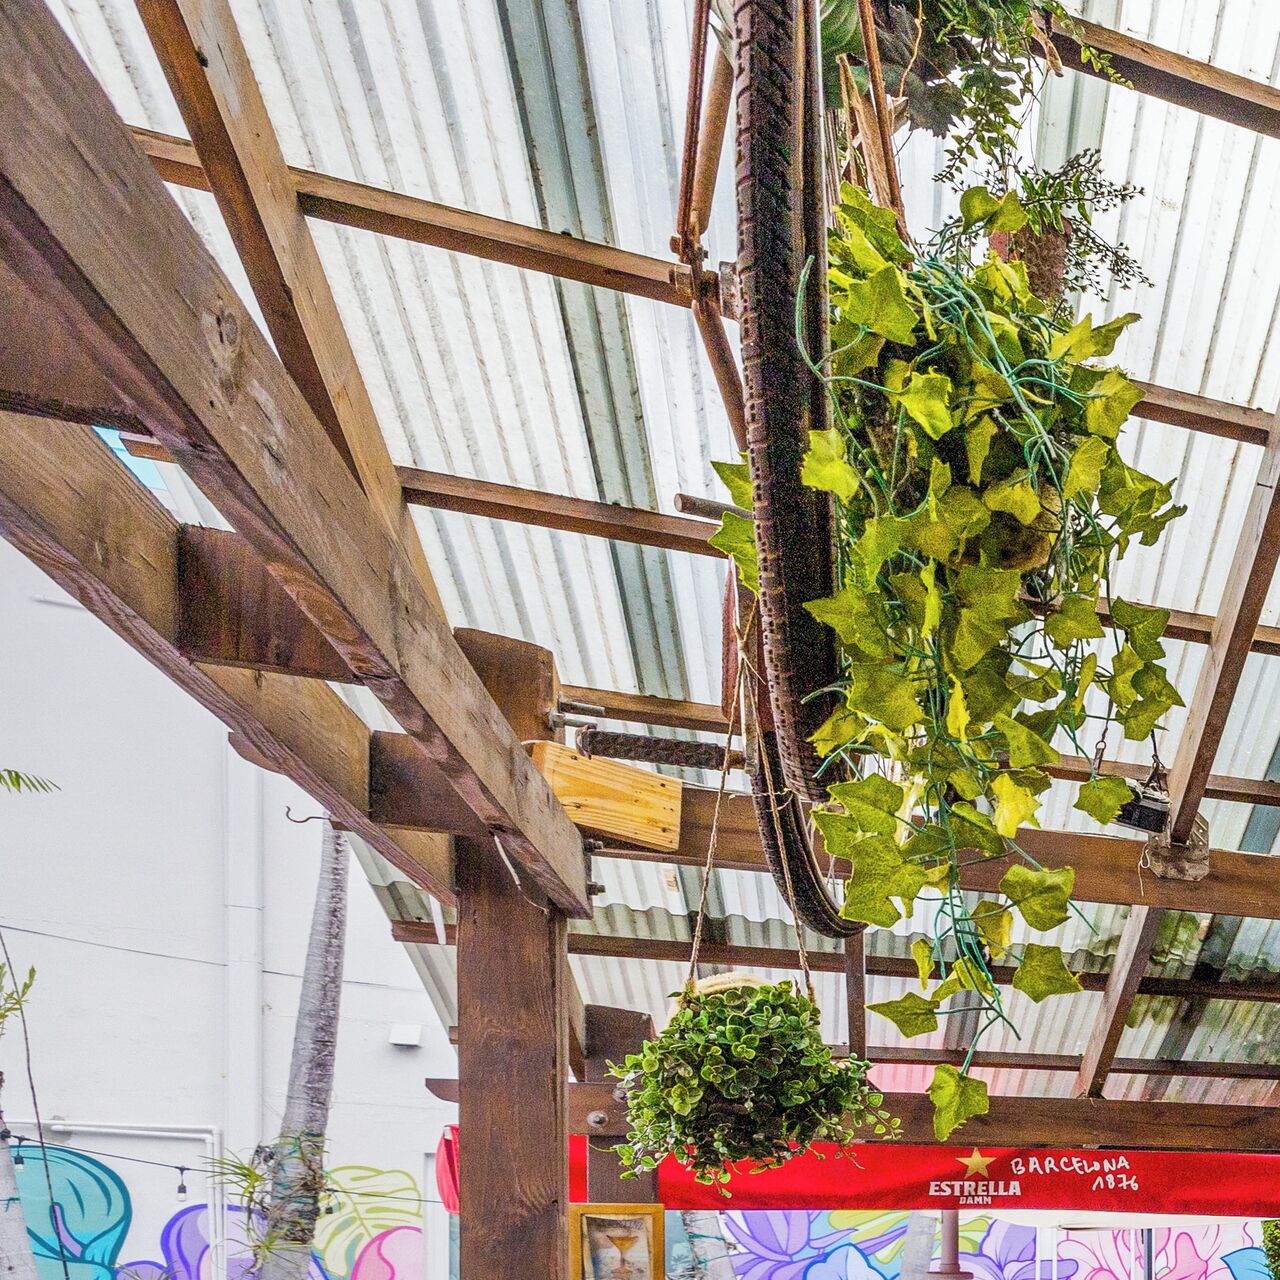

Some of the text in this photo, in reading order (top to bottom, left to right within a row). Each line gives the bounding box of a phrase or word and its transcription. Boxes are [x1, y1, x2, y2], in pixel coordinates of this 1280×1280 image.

[1010, 1155, 1130, 1175] BARCELONA
[928, 1180, 1021, 1196] ESTRELLA
[1092, 1174, 1139, 1191] 1876
[959, 1196, 992, 1205] DAMM
